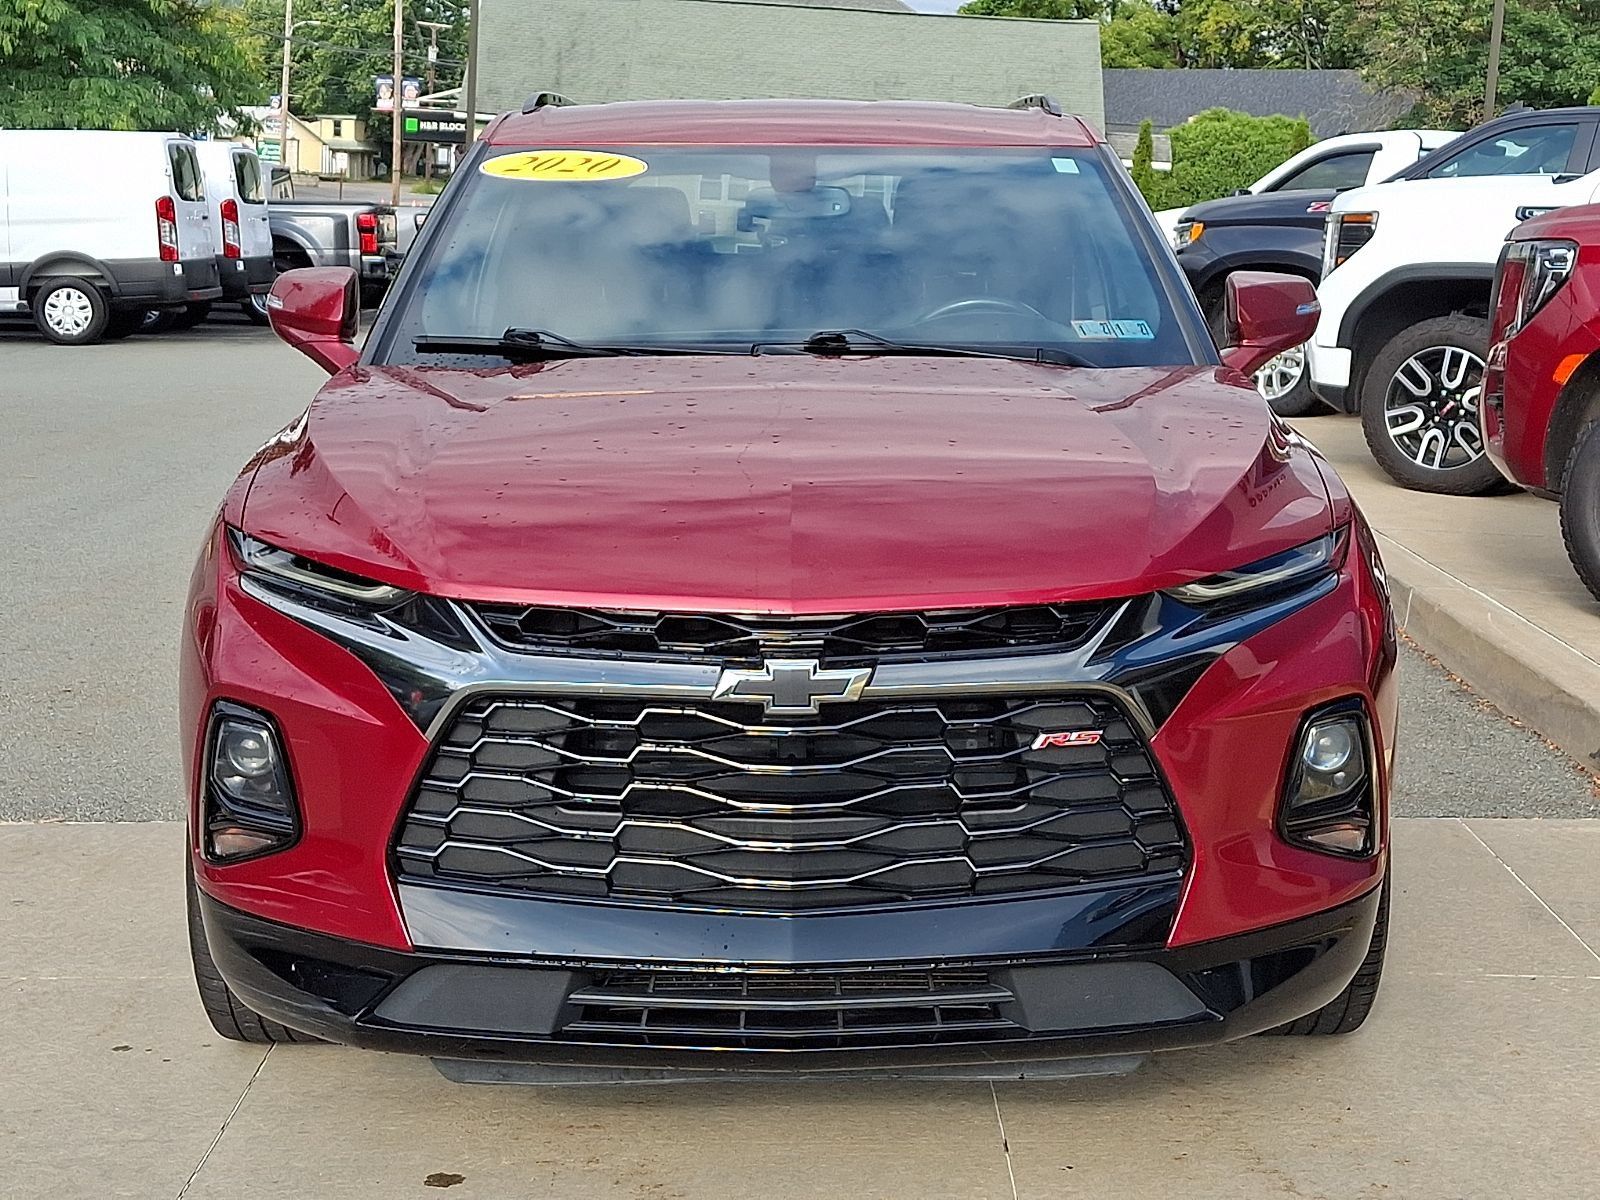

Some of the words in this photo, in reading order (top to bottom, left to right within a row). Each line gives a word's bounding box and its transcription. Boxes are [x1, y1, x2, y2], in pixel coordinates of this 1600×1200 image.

[420, 121, 438, 130] H&R
[439, 122, 466, 131] BLOCK
[503, 156, 621, 173] 2020
[1030, 730, 1104, 750] RS
